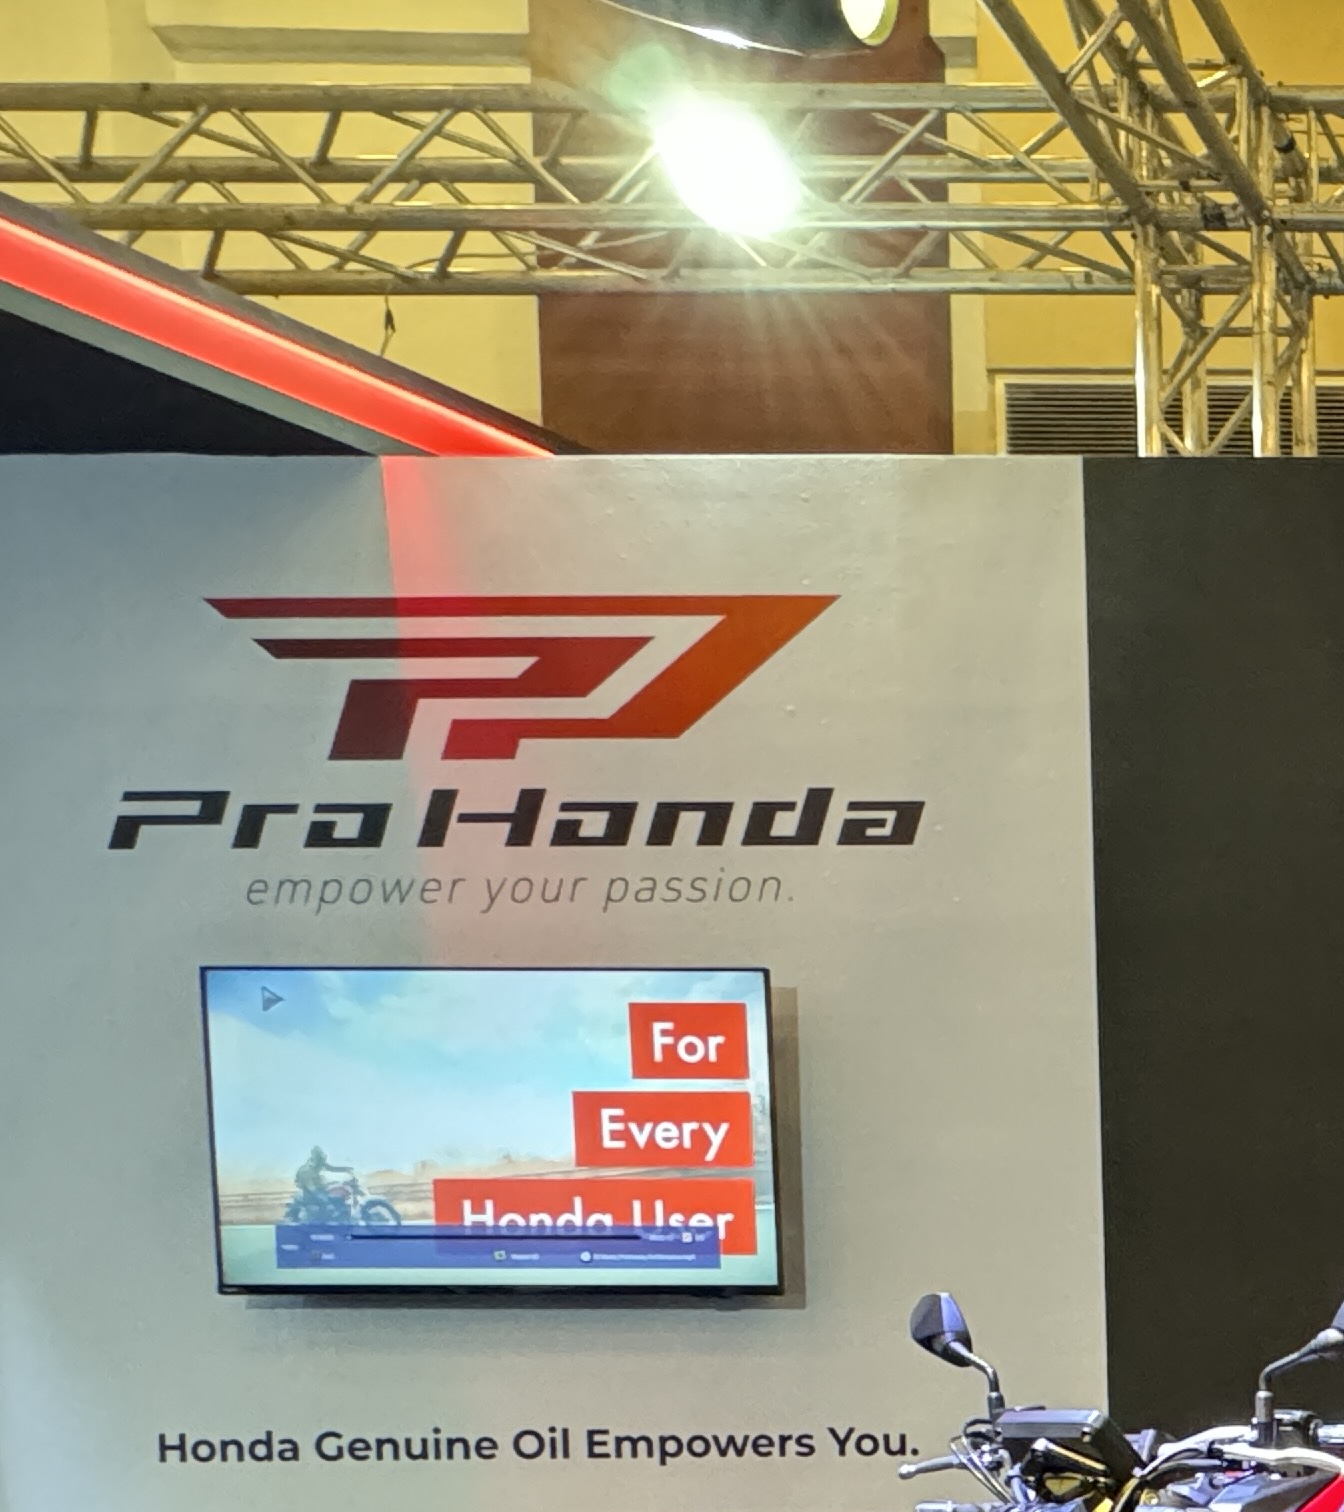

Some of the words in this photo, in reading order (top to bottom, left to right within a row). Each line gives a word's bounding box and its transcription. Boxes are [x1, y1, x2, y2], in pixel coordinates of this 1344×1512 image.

[108, 790, 394, 850] Pro
[417, 787, 926, 848] Honda
[246, 873, 467, 916] empower
[481, 871, 588, 914] your
[602, 866, 797, 914] passion.
[652, 1021, 726, 1064] For
[600, 1108, 730, 1162] Every
[158, 1430, 300, 1463] Honda
[314, 1428, 499, 1461] Genuine
[512, 1426, 570, 1460] Oil
[586, 1429, 816, 1467] Empowers
[827, 1427, 920, 1459] You.
